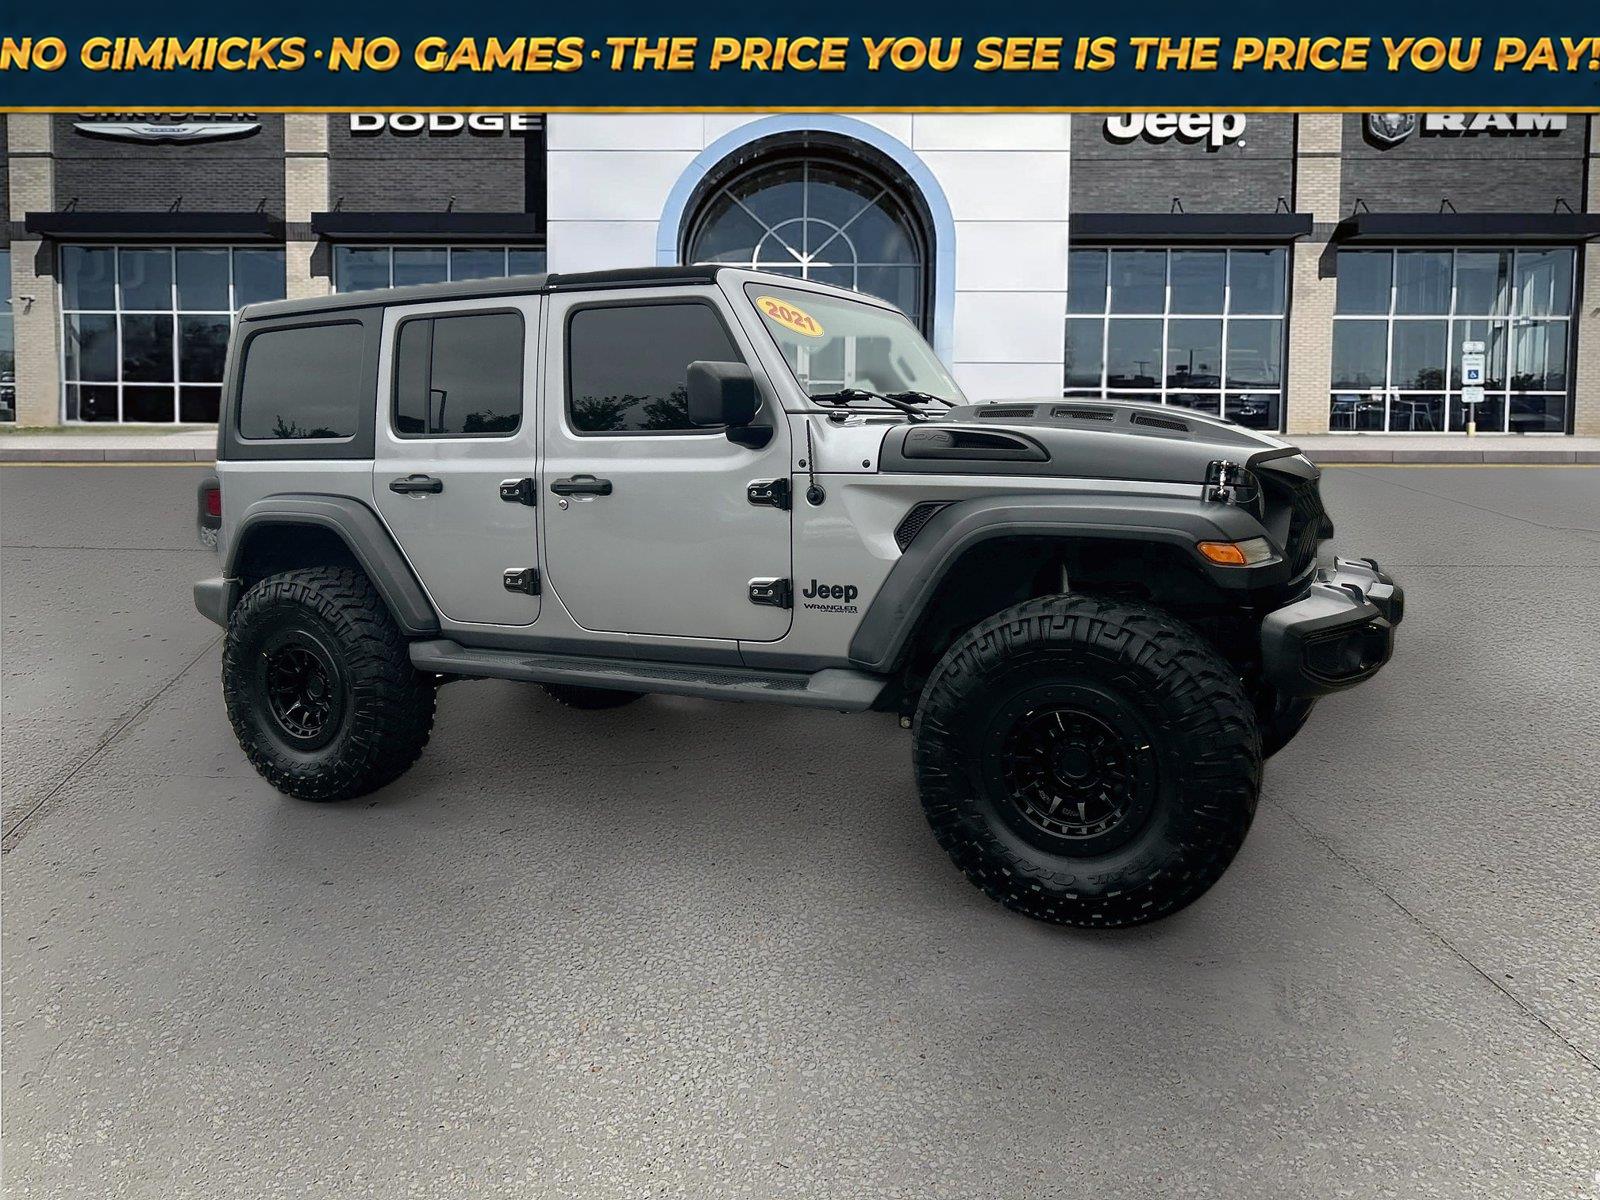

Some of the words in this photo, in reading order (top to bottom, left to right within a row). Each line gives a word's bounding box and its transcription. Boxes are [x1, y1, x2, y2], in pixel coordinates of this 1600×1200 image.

[350, 112, 543, 131] DODGE
[1106, 112, 1247, 147] Jeep
[765, 301, 816, 332] 2021
[802, 579, 858, 603] Jeep
[803, 603, 858, 611] WRANGLER
